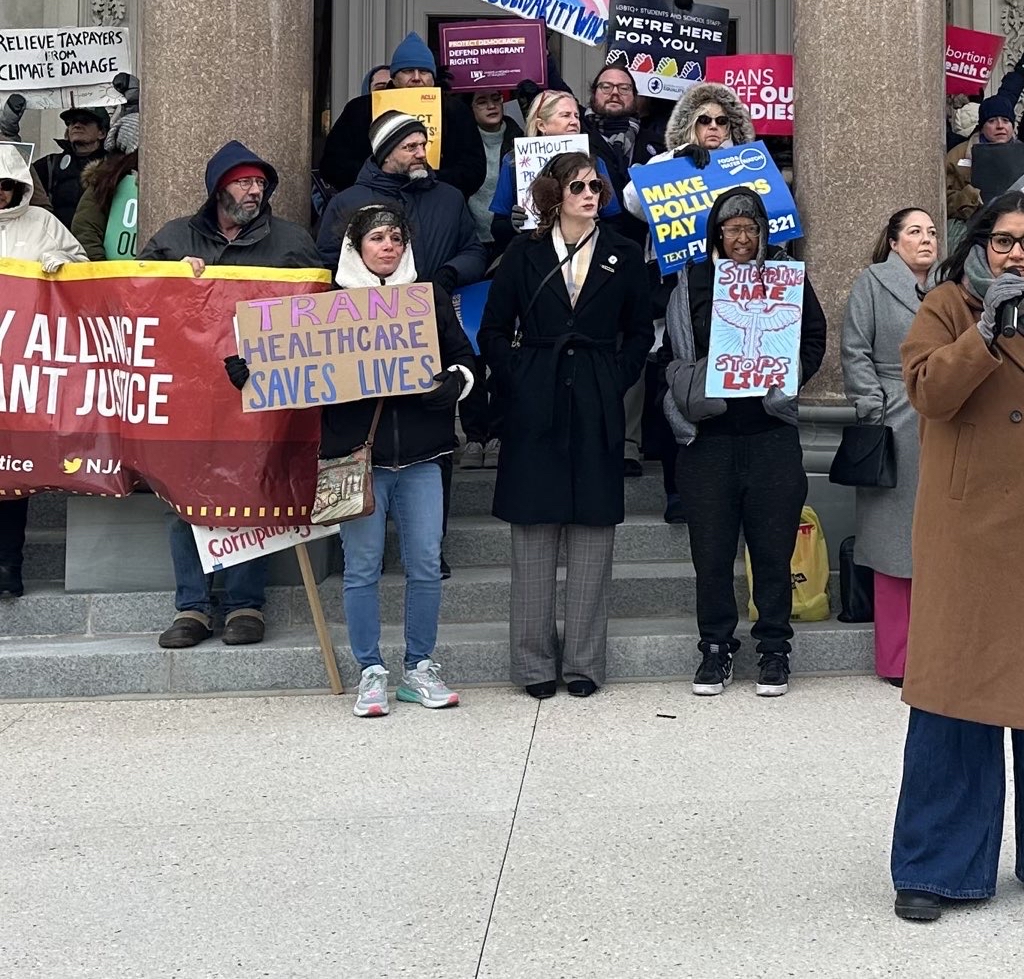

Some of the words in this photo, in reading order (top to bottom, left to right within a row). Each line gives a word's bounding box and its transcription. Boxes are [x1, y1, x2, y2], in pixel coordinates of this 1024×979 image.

[57, 31, 122, 48] TAXPAYERS
[616, 15, 673, 33] WE'RE
[680, 25, 722, 42] HERE
[449, 49, 479, 57] DEFEND
[480, 46, 525, 55] IMMIGRANT
[615, 30, 653, 45] FOR
[659, 37, 699, 53] YOU.
[45, 50, 77, 61] FROM
[449, 57, 479, 66] RIGHTS!
[0, 63, 55, 80] CLIMATE
[61, 57, 118, 76] DAMAGE
[725, 69, 773, 86] BANS
[517, 140, 573, 155] WITHOUT
[641, 176, 708, 204] MAKE
[655, 215, 697, 243] PAY
[663, 249, 688, 263] TEXT
[729, 283, 787, 302] CARE
[249, 286, 431, 331] TRANS
[23, 313, 159, 367] ALLIANCE
[244, 321, 428, 364] HEALTHCARE
[715, 354, 791, 375] STOPS
[250, 363, 337, 409] SAVES
[358, 355, 435, 395] LIVES
[723, 372, 785, 390] LIVES
[75, 369, 173, 425] JUSTICE
